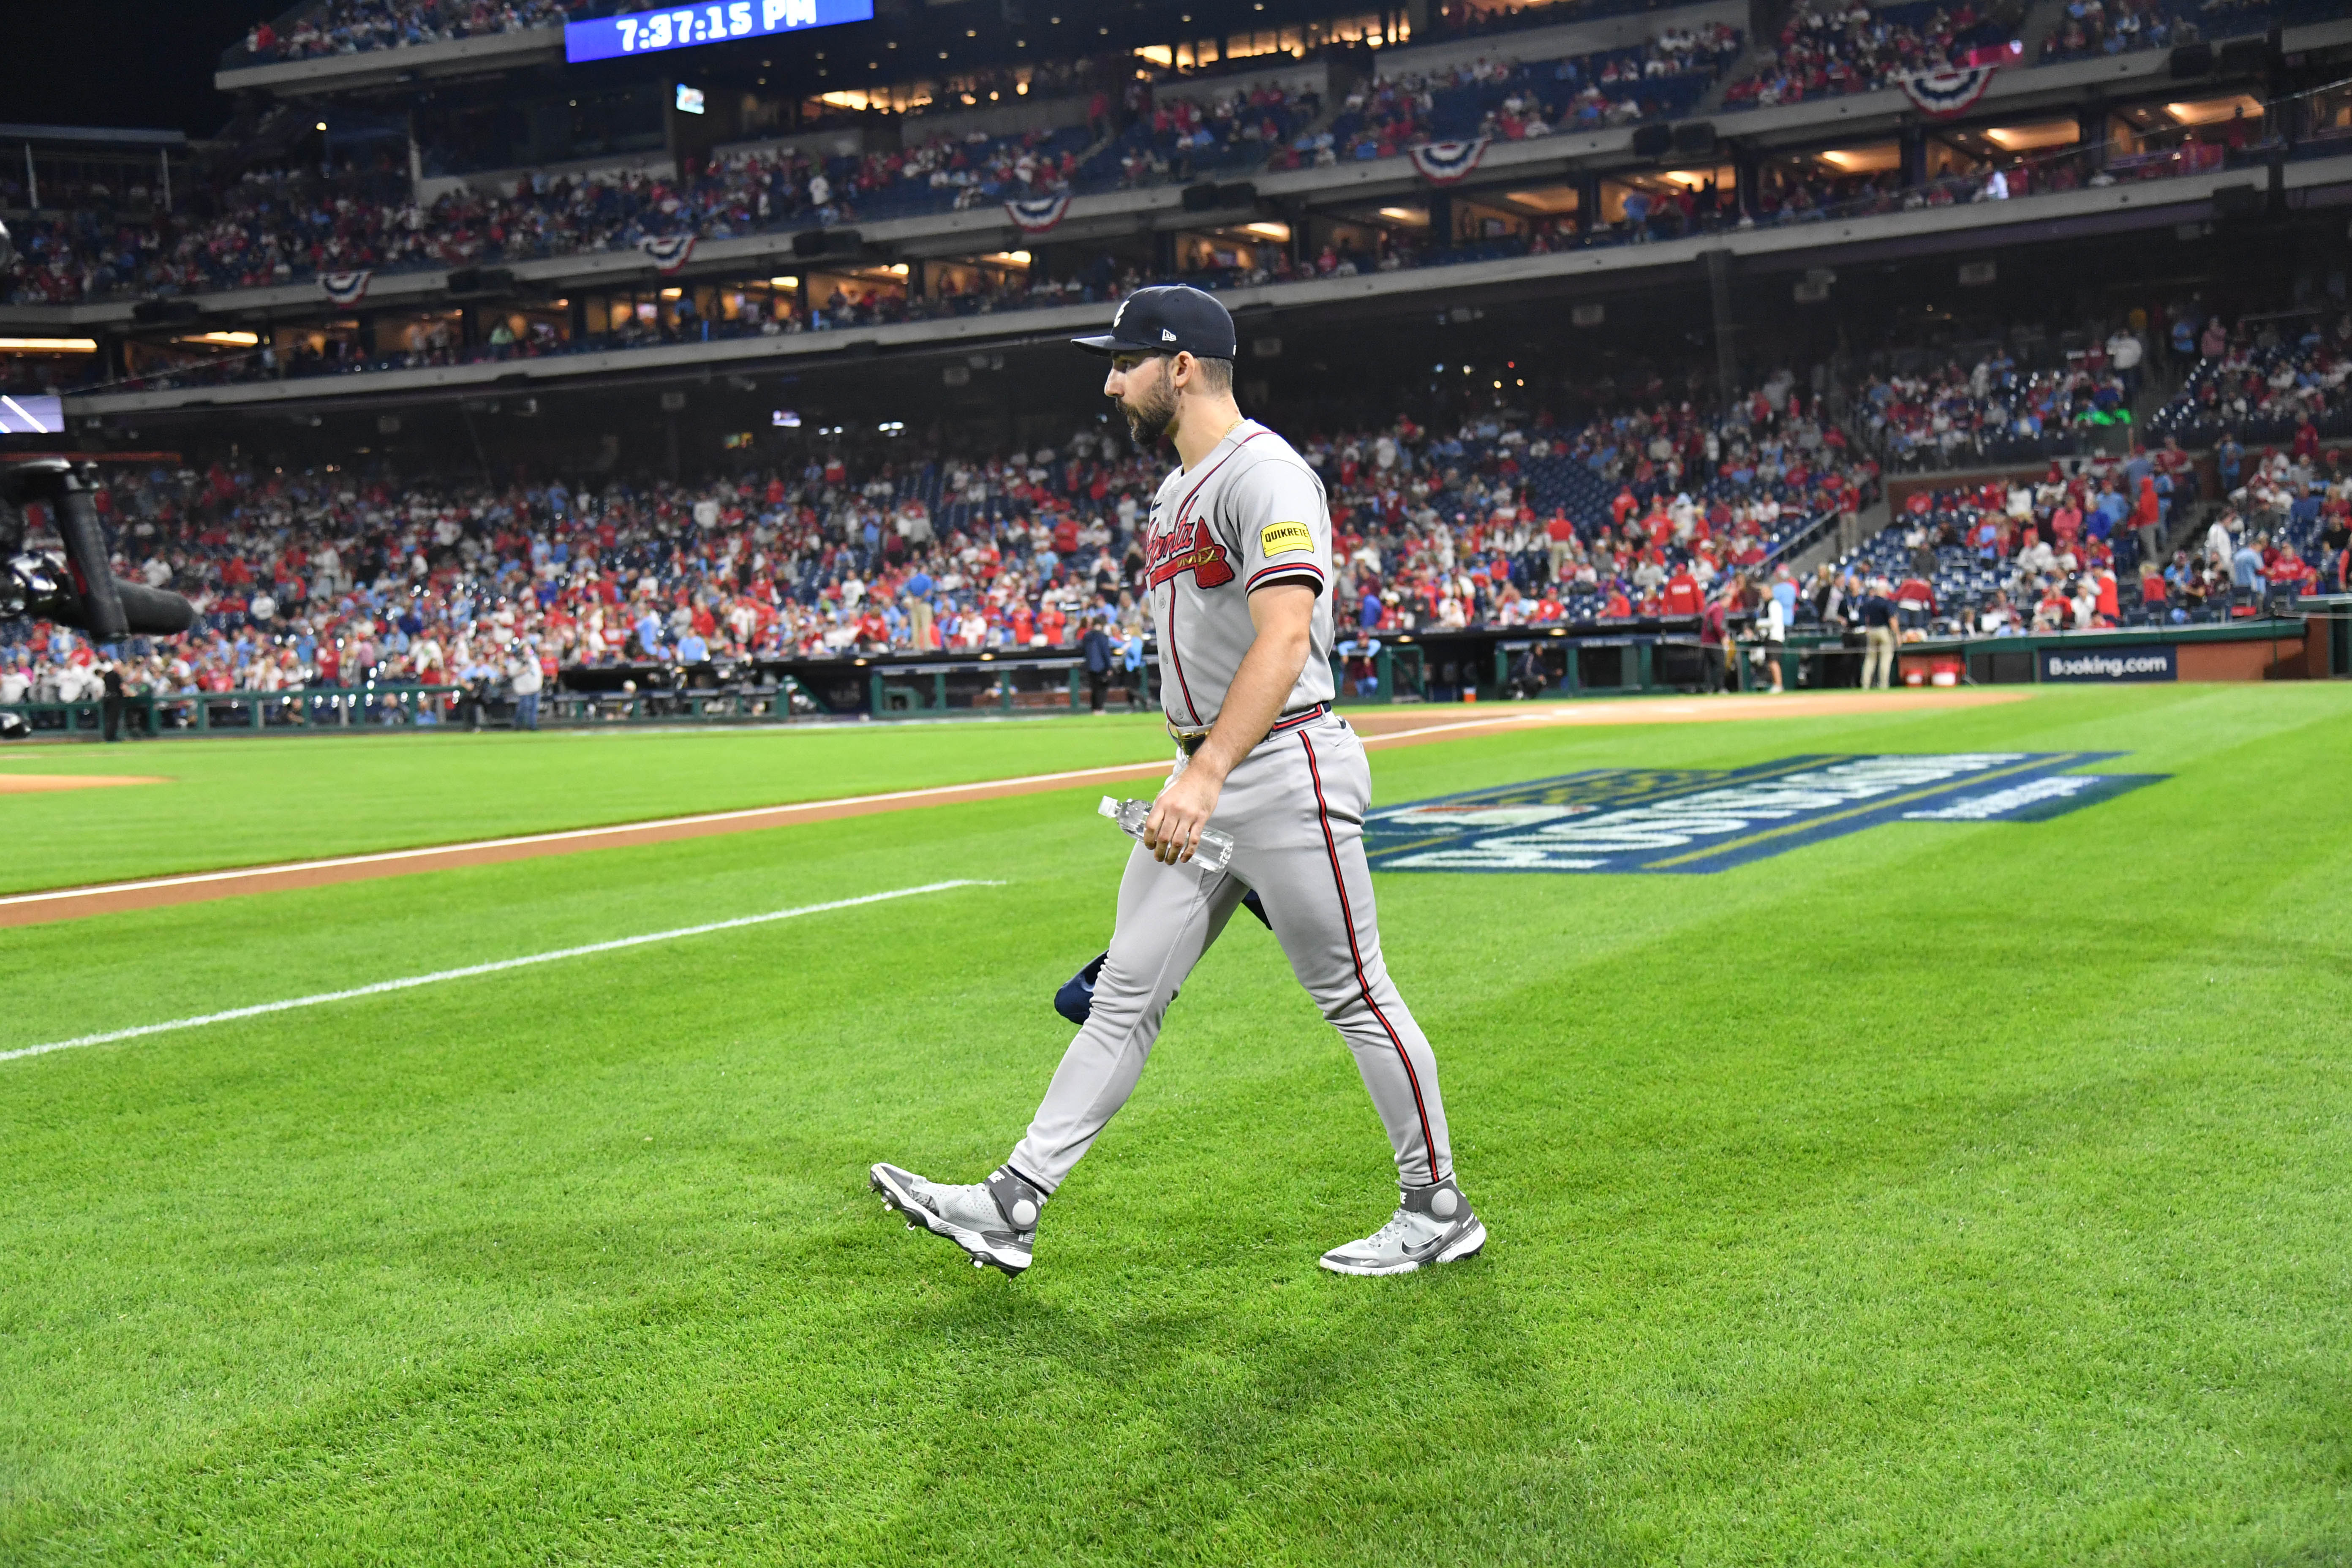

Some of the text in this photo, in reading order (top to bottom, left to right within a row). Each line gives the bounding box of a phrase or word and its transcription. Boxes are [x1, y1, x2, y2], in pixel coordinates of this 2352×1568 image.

[616, 0, 817, 51] 7:37:15 PM
[1265, 528, 1308, 542] QUIKRETE
[2050, 655, 2167, 677] Booking.com
